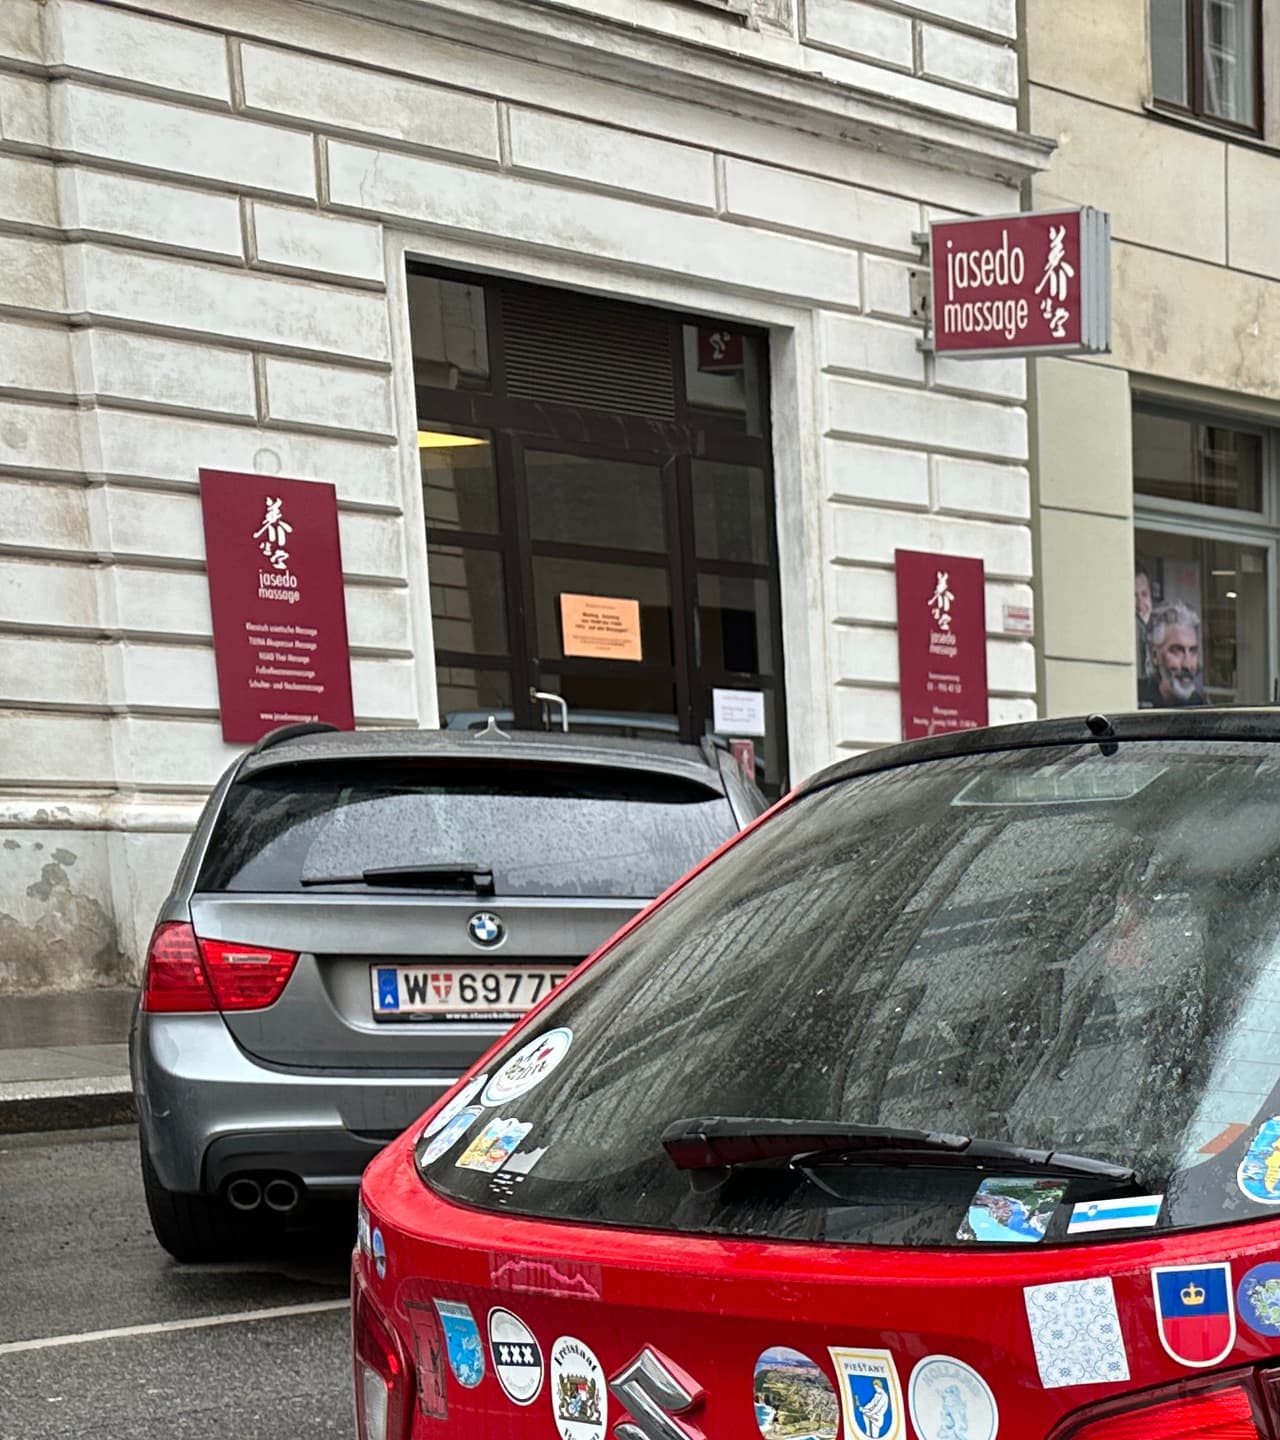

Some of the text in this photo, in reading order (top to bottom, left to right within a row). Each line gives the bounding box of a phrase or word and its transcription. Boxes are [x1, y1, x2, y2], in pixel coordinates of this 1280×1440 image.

[946, 229, 1025, 301] jasedo
[944, 298, 1028, 340] massage
[259, 569, 297, 588] jasedo
[258, 587, 300, 604] massage
[385, 994, 394, 1005] A
[404, 973, 428, 1005] W
